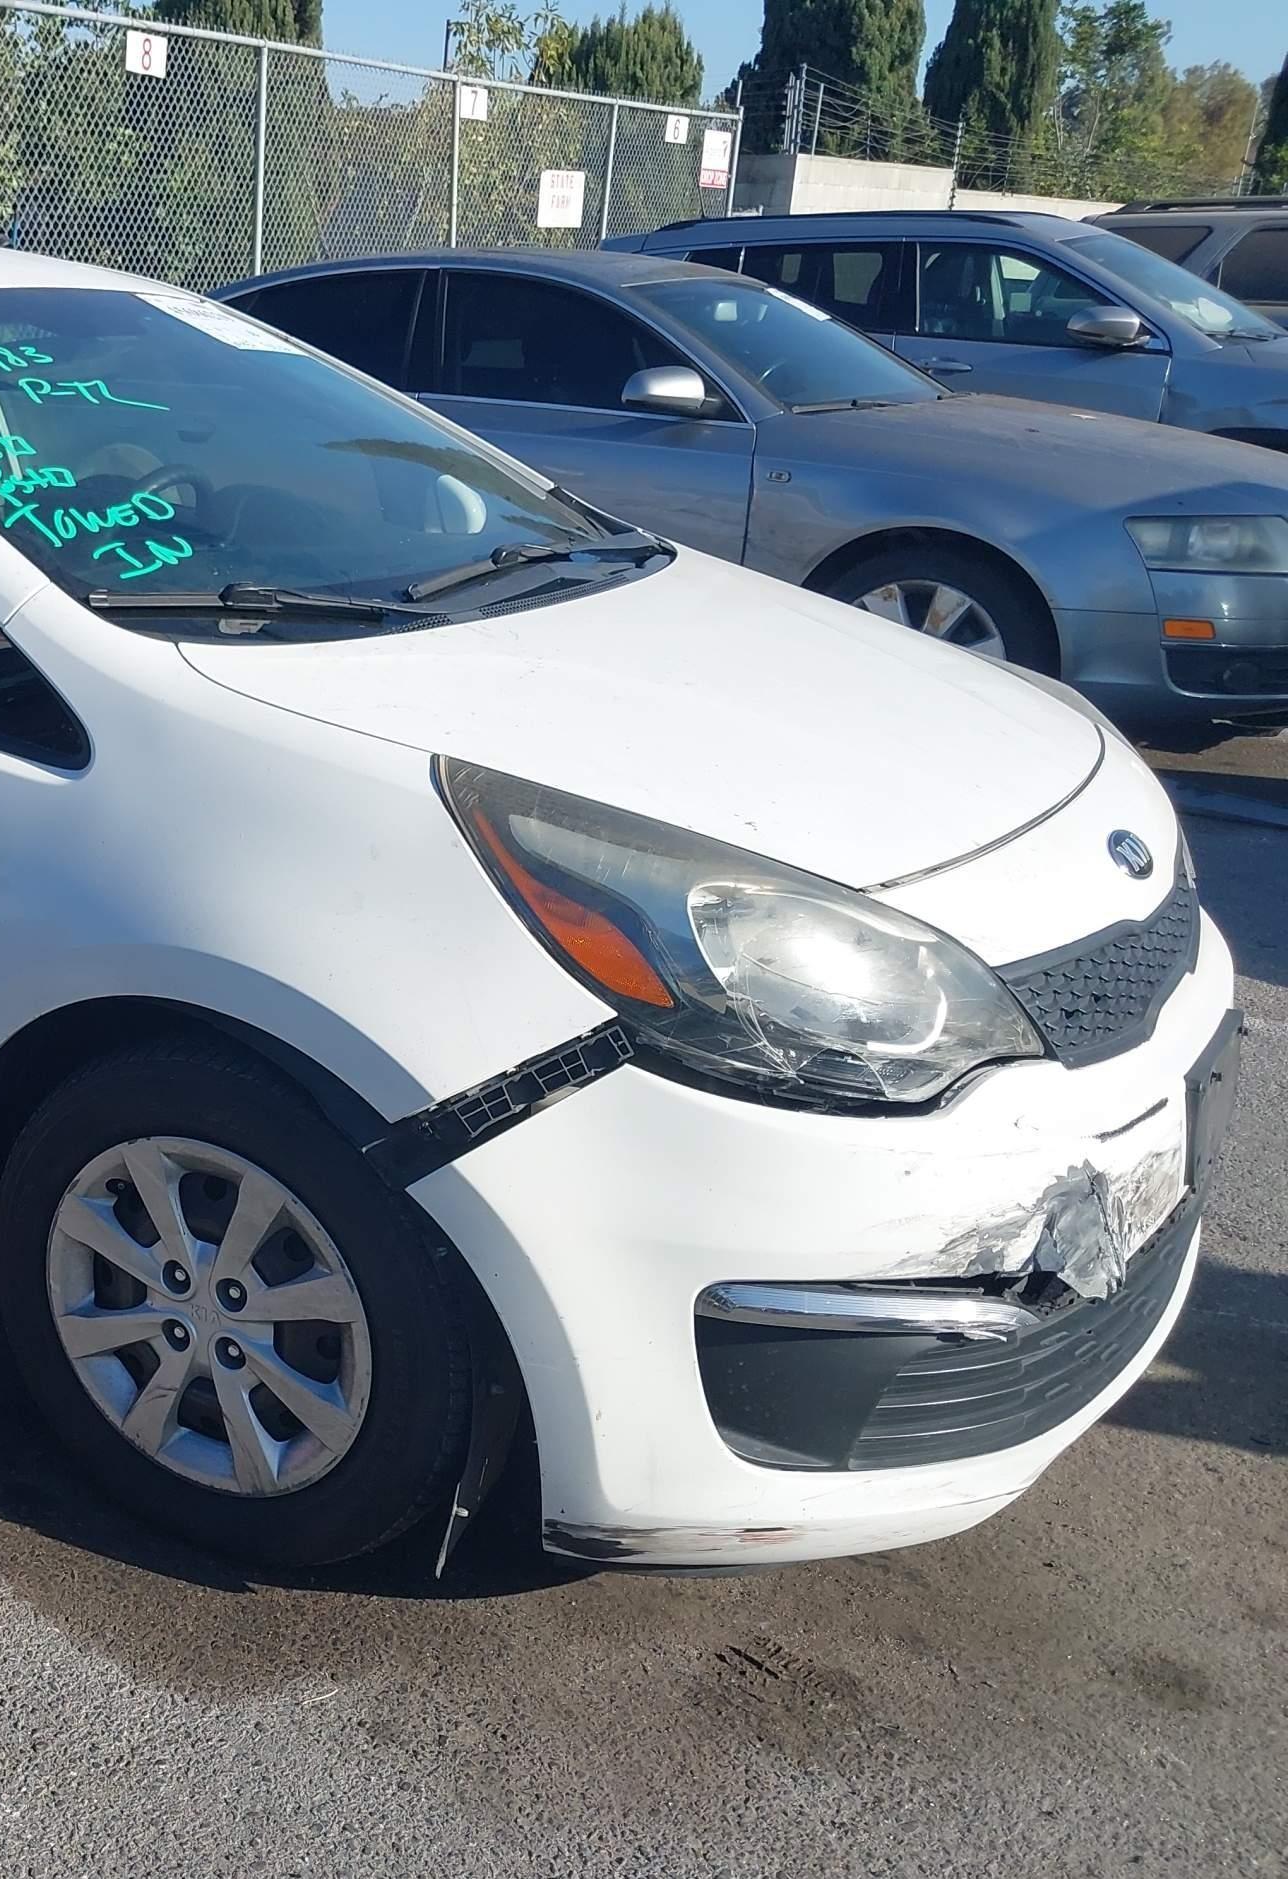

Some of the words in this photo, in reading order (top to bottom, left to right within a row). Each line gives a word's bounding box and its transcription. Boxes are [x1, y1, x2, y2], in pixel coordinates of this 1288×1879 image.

[141, 37, 152, 71] 8
[470, 89, 479, 116] 7
[672, 118, 681, 140] 6
[550, 174, 574, 189] STATE
[3, 491, 176, 548] TOWED
[92, 535, 194, 579] IN
